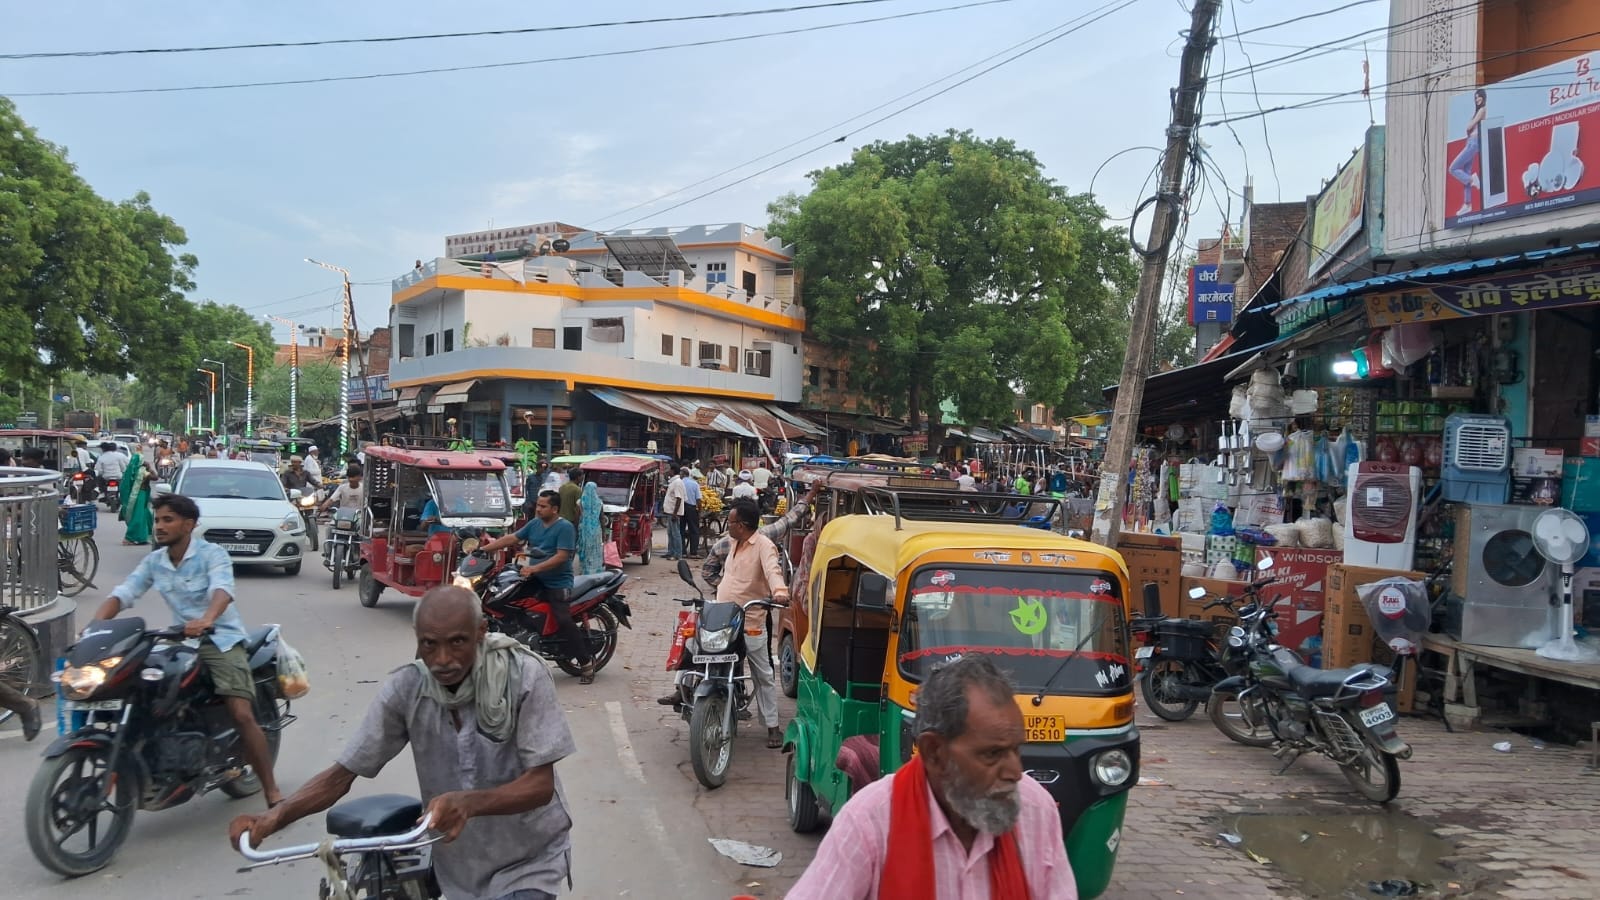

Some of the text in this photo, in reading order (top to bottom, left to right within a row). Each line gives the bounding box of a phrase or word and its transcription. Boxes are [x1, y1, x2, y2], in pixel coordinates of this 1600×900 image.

[1549, 81, 1580, 106] Bill
[1518, 123, 1530, 133] LED
[1531, 117, 1551, 129] LIGHTS
[1555, 109, 1587, 122] MODULAR
[1455, 282, 1502, 309] रवि
[1282, 553, 1341, 563] WINDSOR
[1258, 566, 1291, 579] DIL KI
[1028, 717, 1056, 728] UP73
[1366, 711, 1391, 725] 4003
[1025, 729, 1060, 740] T6510
